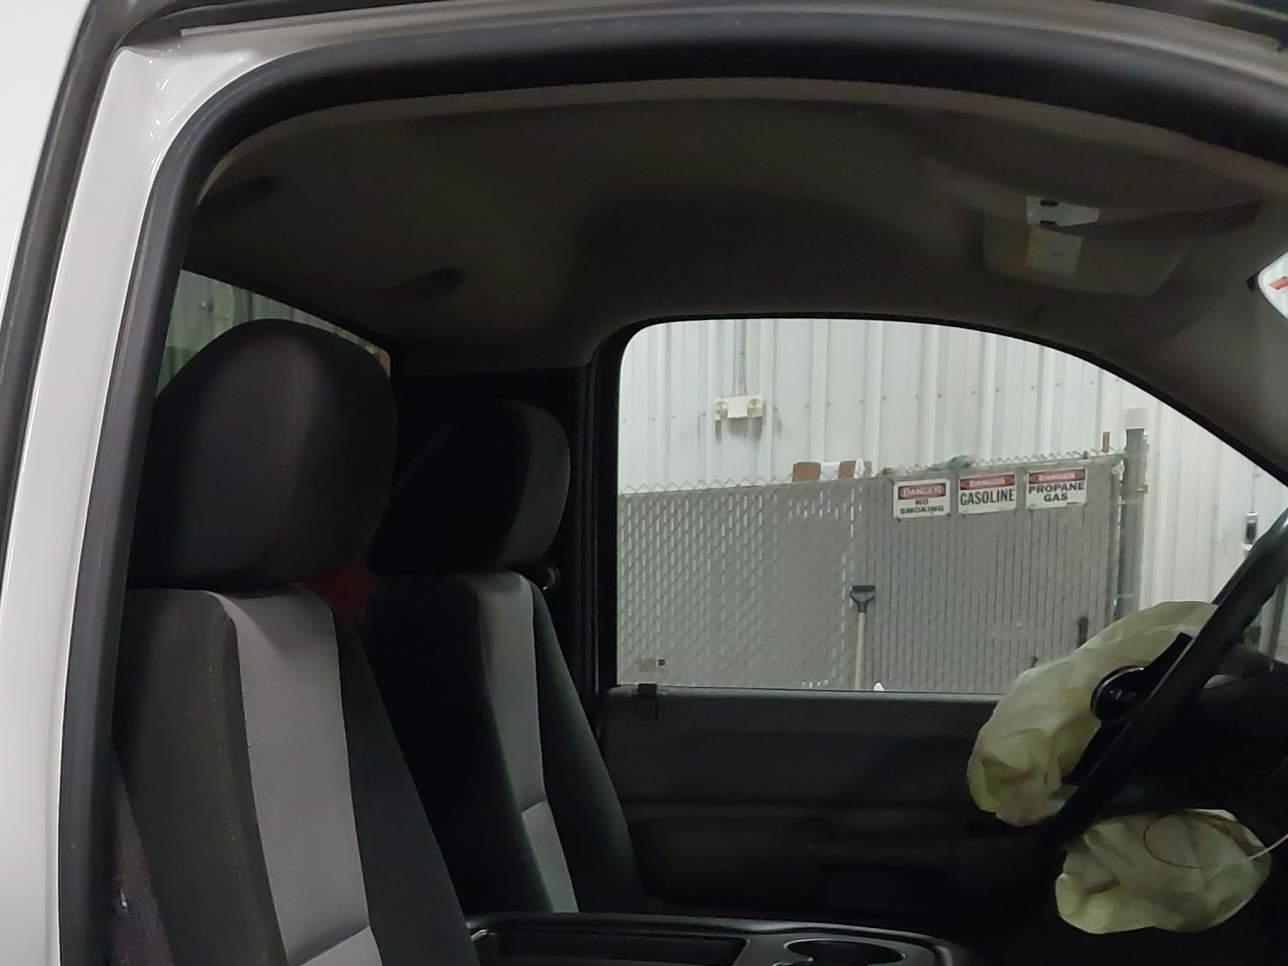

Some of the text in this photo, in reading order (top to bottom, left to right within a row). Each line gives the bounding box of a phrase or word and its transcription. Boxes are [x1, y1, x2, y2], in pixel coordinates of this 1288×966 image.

[1028, 482, 1085, 494] PROPANE
[960, 488, 1015, 506] GASOLINE
[1043, 492, 1069, 502] GAS
